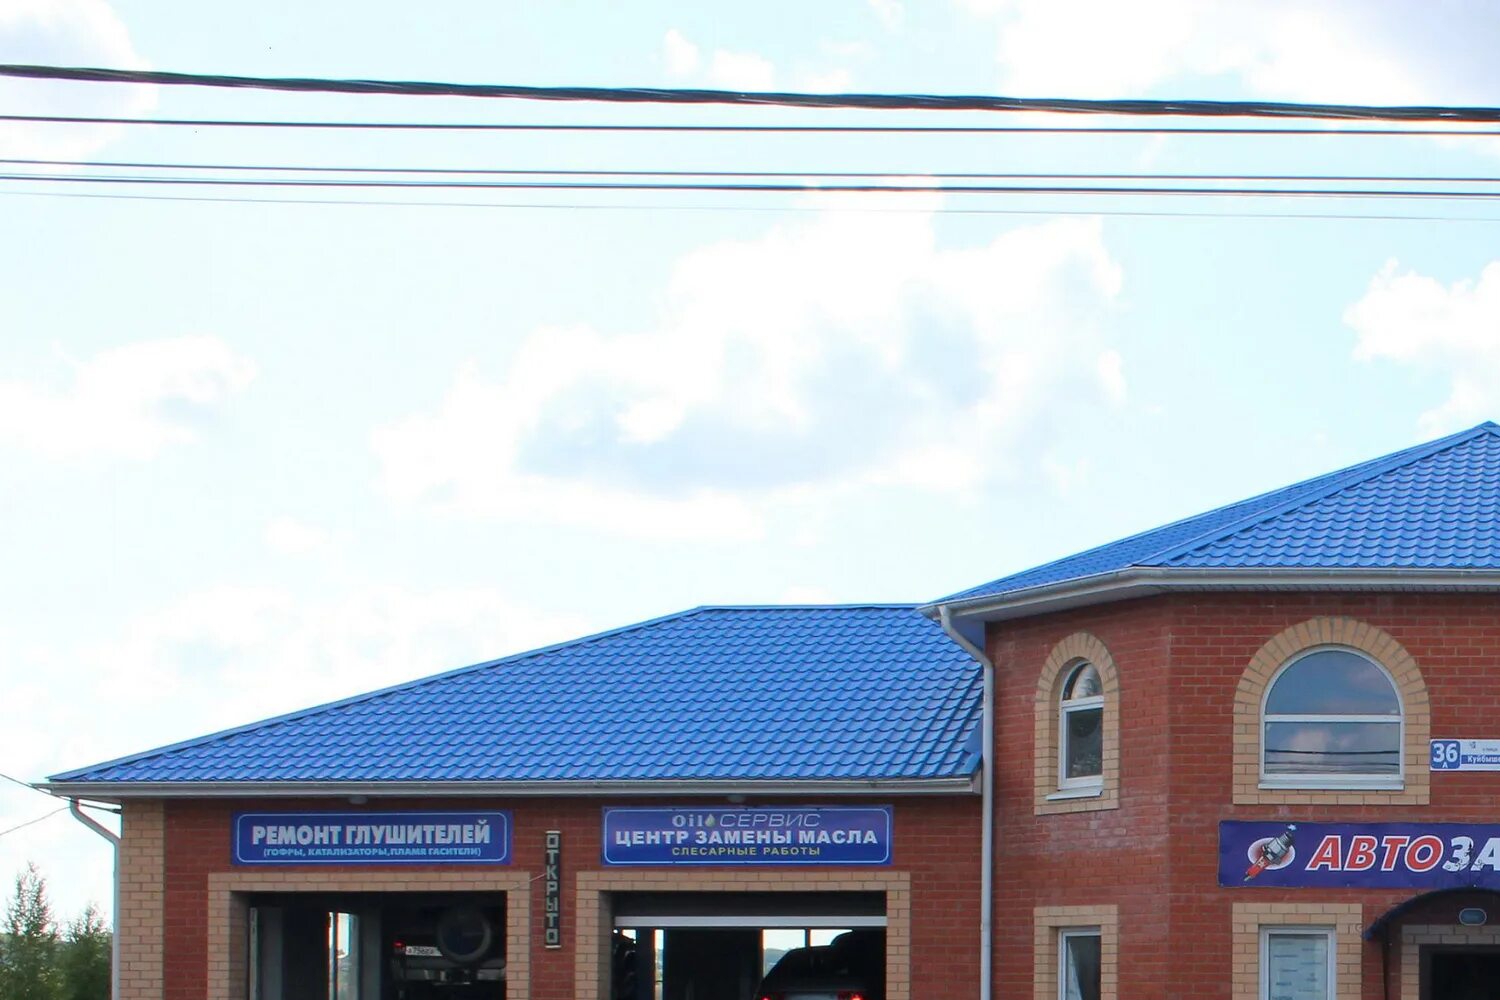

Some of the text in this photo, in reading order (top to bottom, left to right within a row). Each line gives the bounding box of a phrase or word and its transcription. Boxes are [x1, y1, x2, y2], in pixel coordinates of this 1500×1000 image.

[1432, 742, 1458, 763] 36
[671, 813, 821, 827] Oil СЕРВИС
[252, 819, 491, 845] РЕМОНТ ГЛУШИТЕЛЕЙ
[615, 829, 878, 847] ЦЕНТР ЗАМЕНЫ МАСЛА
[671, 847, 820, 856] СЛЕСАРНЫЕ РАБОТЫ
[546, 834, 560, 944] ОТКРЫТО
